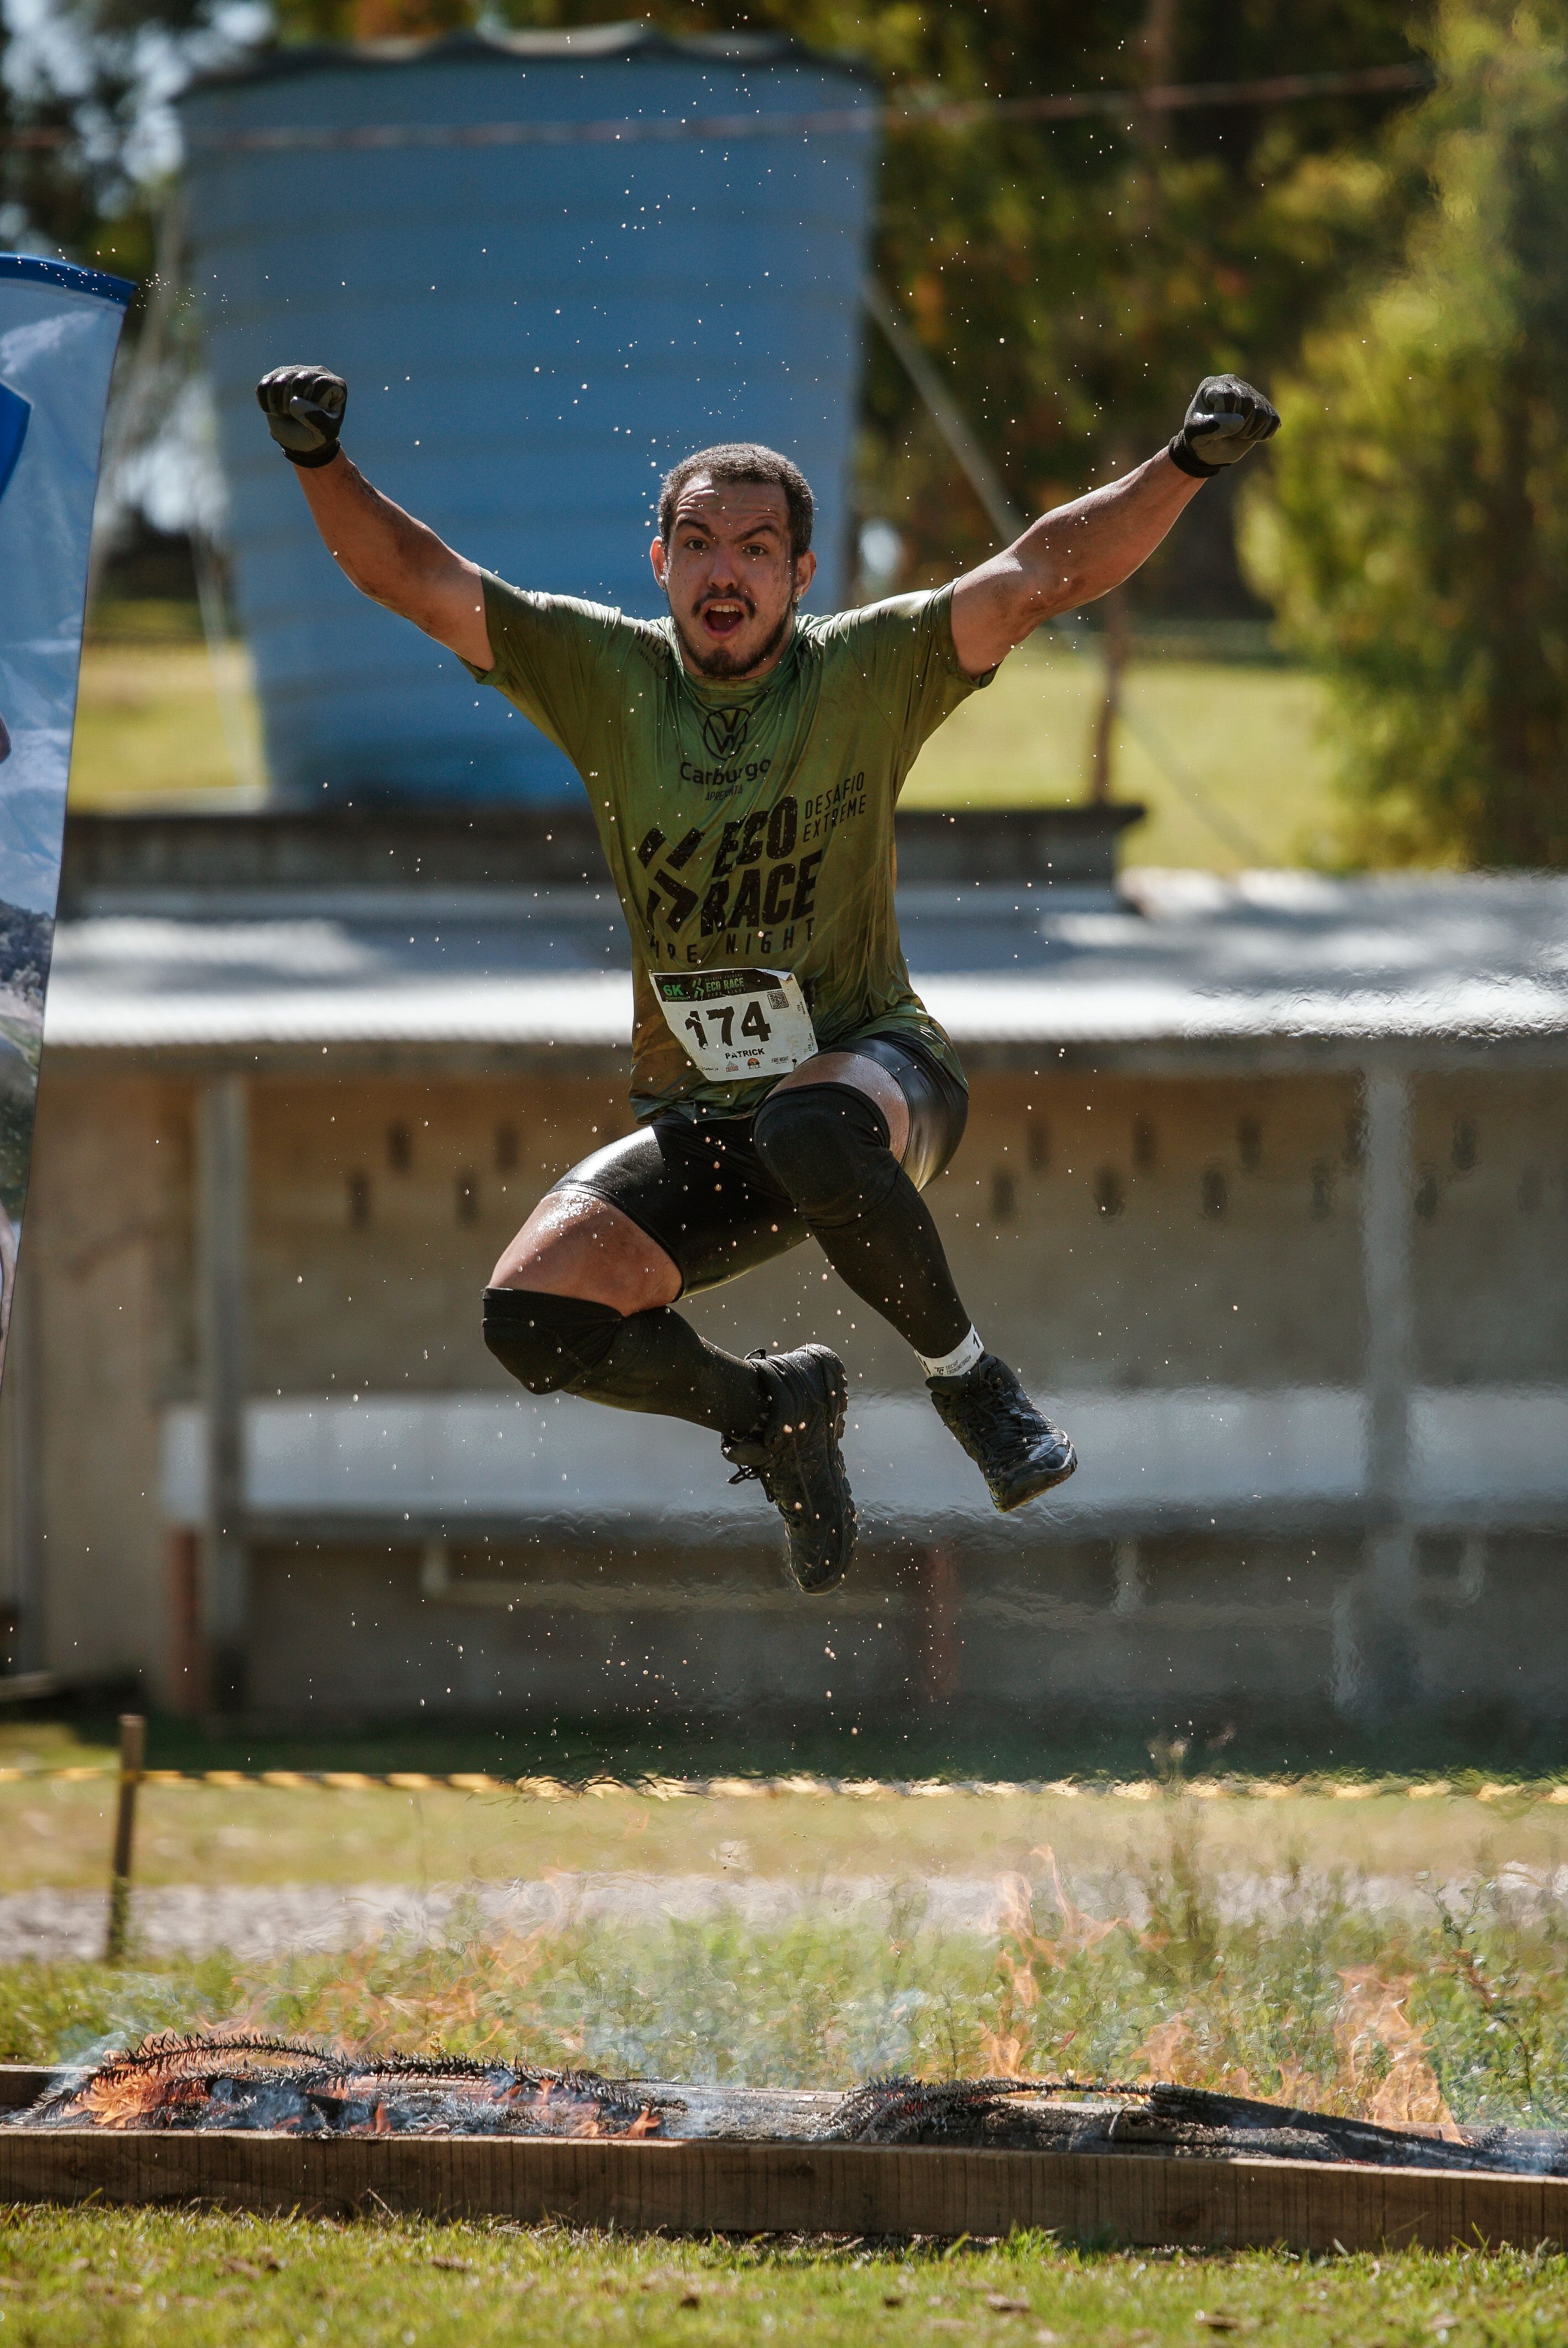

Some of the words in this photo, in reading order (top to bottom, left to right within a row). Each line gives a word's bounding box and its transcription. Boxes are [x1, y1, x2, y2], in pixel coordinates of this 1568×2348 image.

[680, 759, 771, 785] Carburgo
[804, 772, 865, 820] DESAFIO
[711, 796, 798, 878] ECO
[803, 794, 866, 843] EXTREME
[700, 848, 823, 938] RACE
[725, 917, 815, 955] NIGHT
[663, 984, 684, 997] 6K
[706, 981, 721, 993] ECO
[724, 977, 745, 990] RACE
[685, 1001, 772, 1051] 174
[725, 1048, 765, 1059] PATRICK
